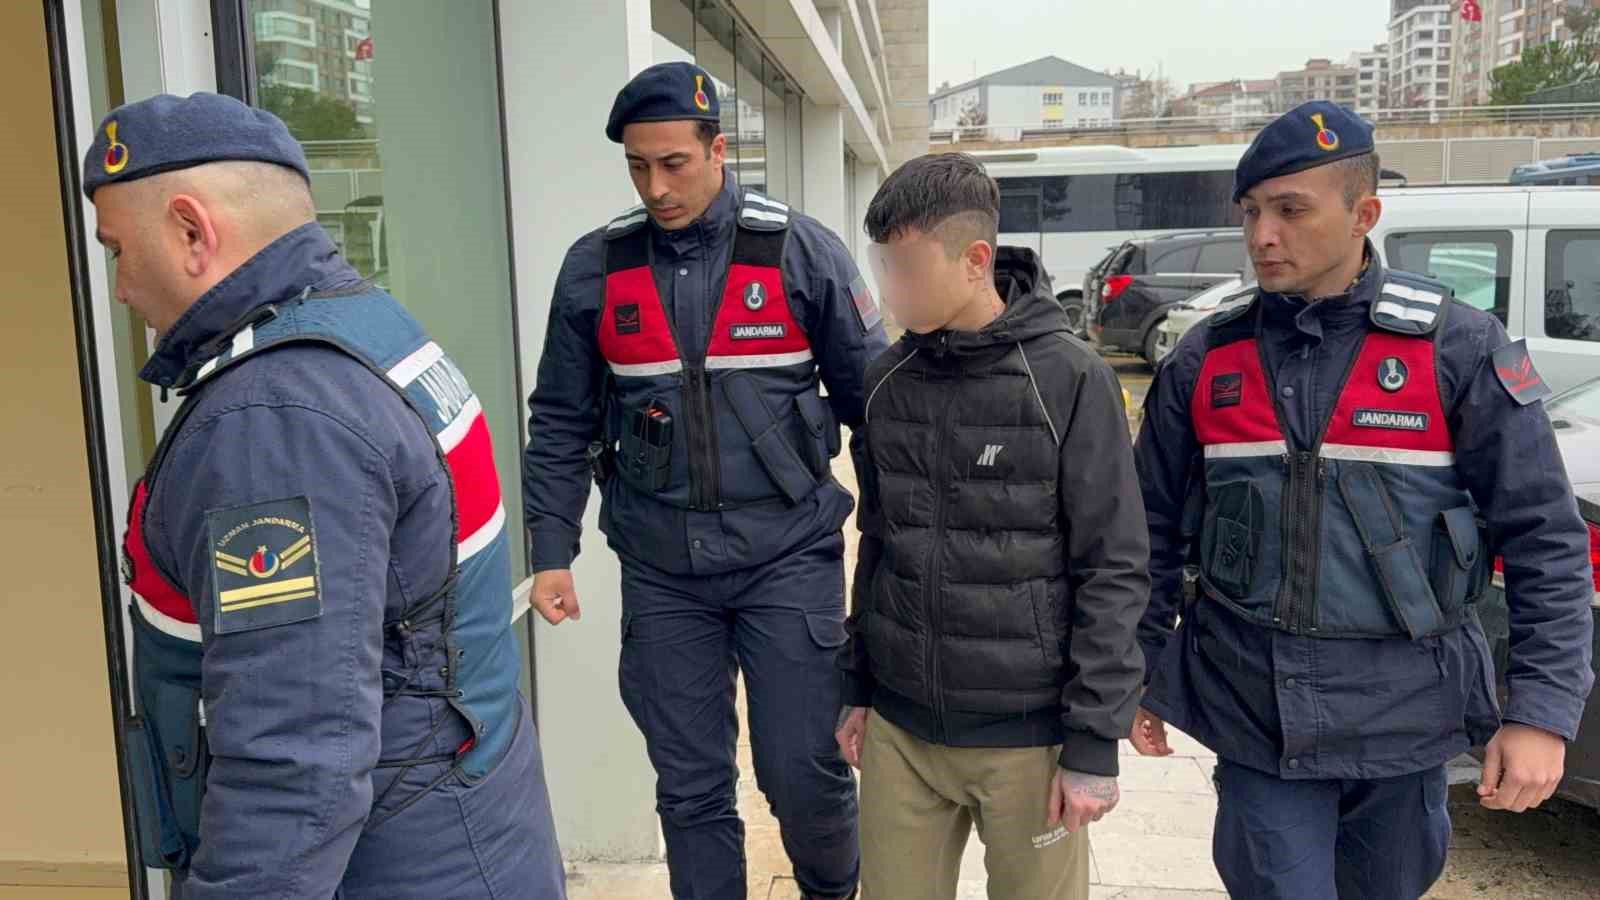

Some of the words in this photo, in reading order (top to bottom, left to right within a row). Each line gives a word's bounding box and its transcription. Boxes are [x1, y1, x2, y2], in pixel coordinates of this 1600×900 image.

[733, 325, 783, 337] JANDARMA
[1358, 411, 1424, 428] JANDARMA
[252, 516, 305, 534] JANDARMA
